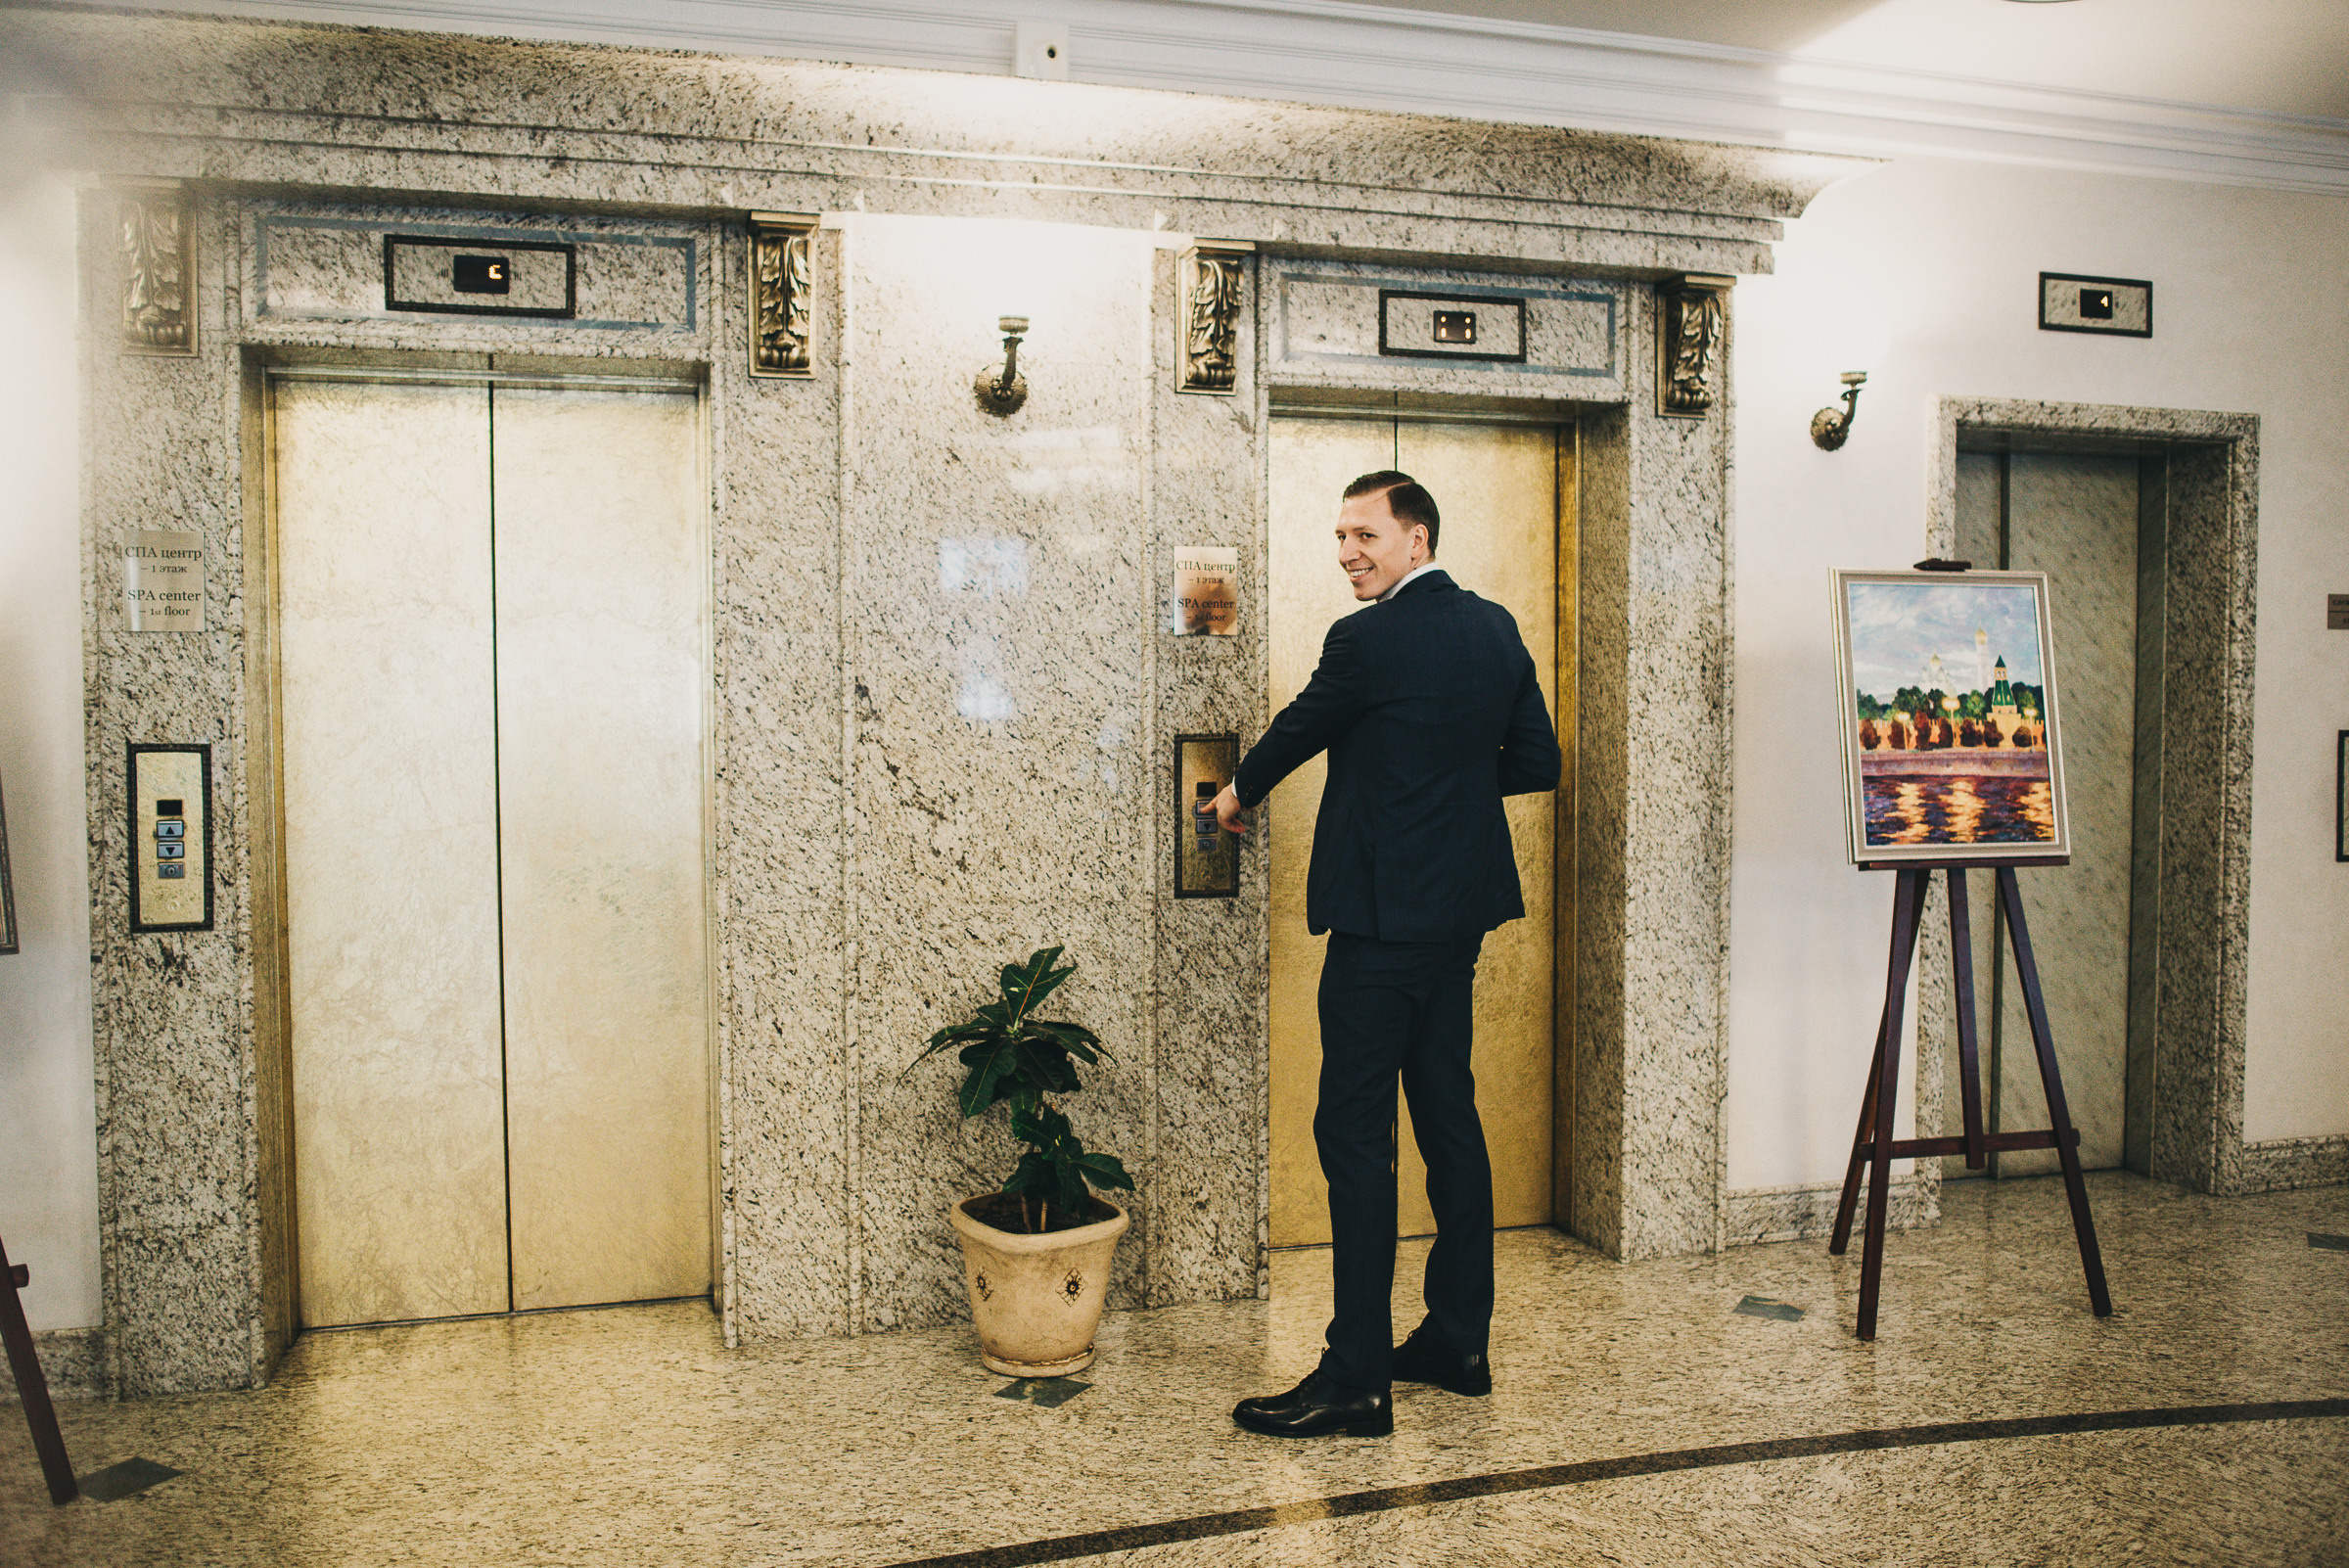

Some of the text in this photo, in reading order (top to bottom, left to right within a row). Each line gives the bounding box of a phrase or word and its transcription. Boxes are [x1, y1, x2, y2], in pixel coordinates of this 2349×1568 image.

[124, 546, 202, 561] СПА центр
[159, 565, 188, 574] этаж
[1175, 561, 1235, 574] СПА центр
[127, 589, 202, 602] SPA center
[1177, 597, 1234, 609] SPA center
[164, 605, 191, 617] floor
[1206, 612, 1226, 622] floor
